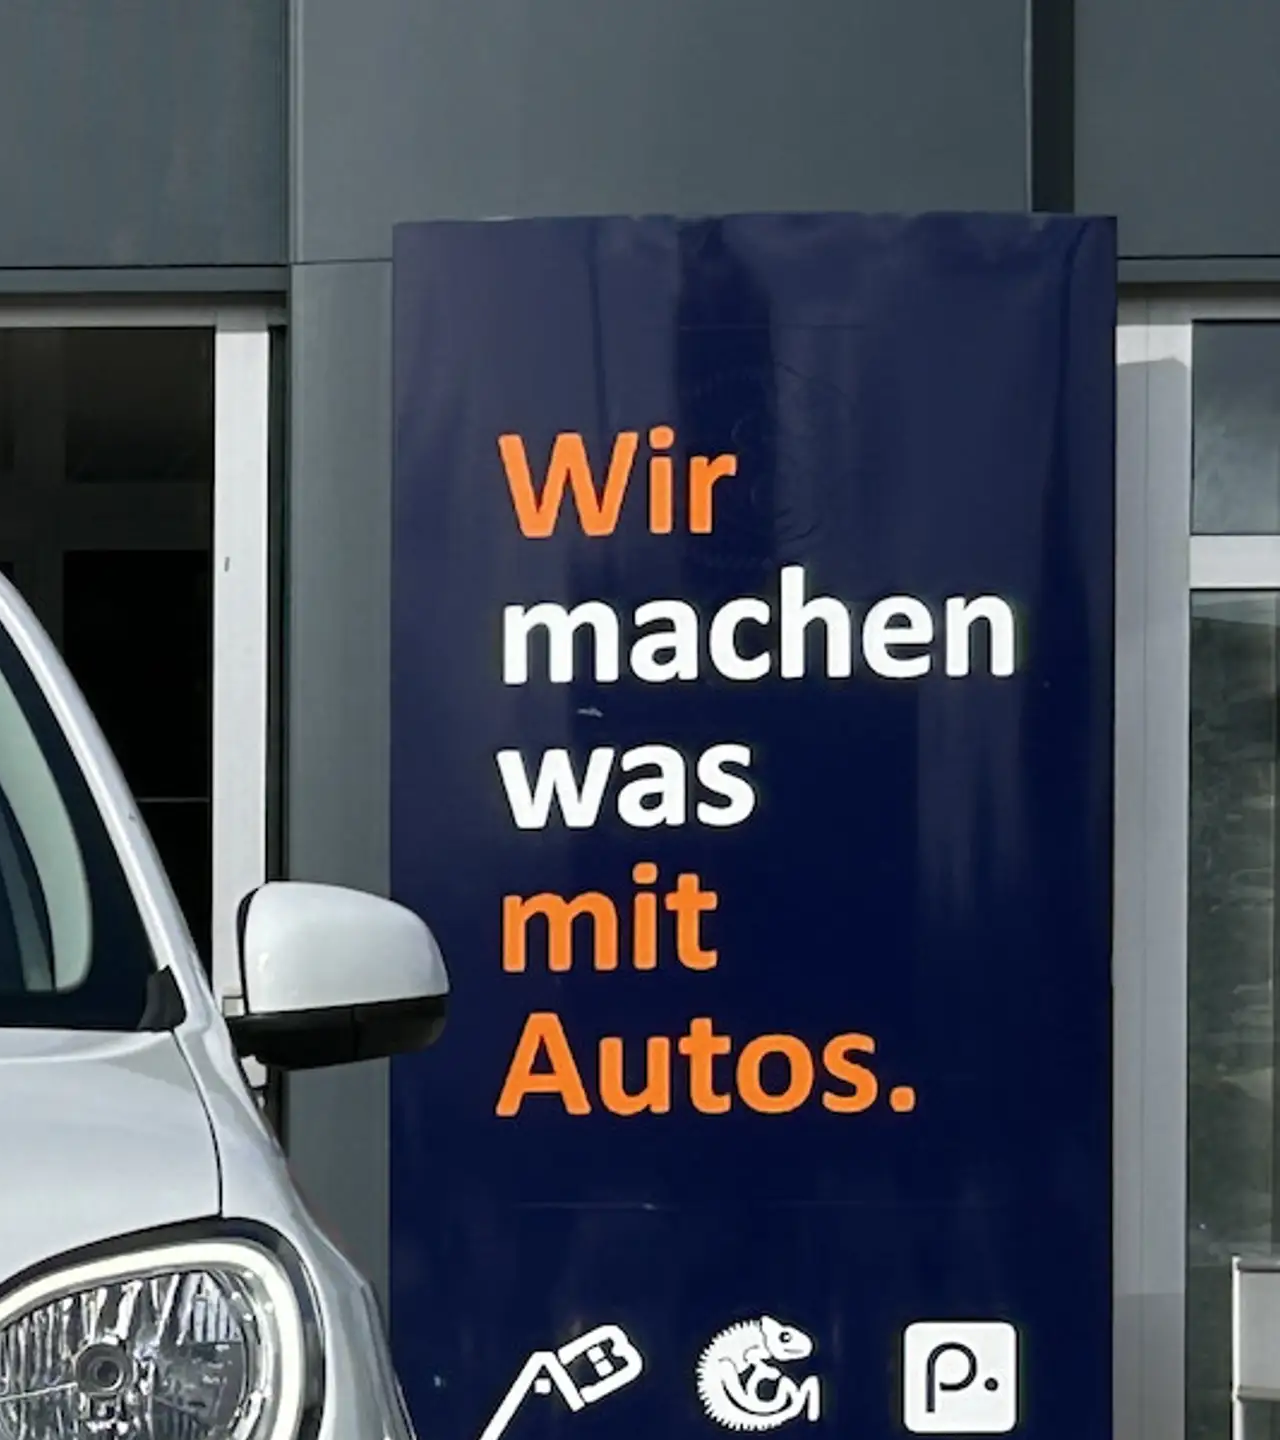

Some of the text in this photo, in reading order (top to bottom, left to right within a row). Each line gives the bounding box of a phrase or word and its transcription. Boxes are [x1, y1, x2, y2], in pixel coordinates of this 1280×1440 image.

[497, 425, 738, 539] Wir
[502, 565, 1016, 686] machen
[495, 742, 757, 830] was
[502, 862, 719, 973] mit
[495, 1012, 918, 1118] Autos.
